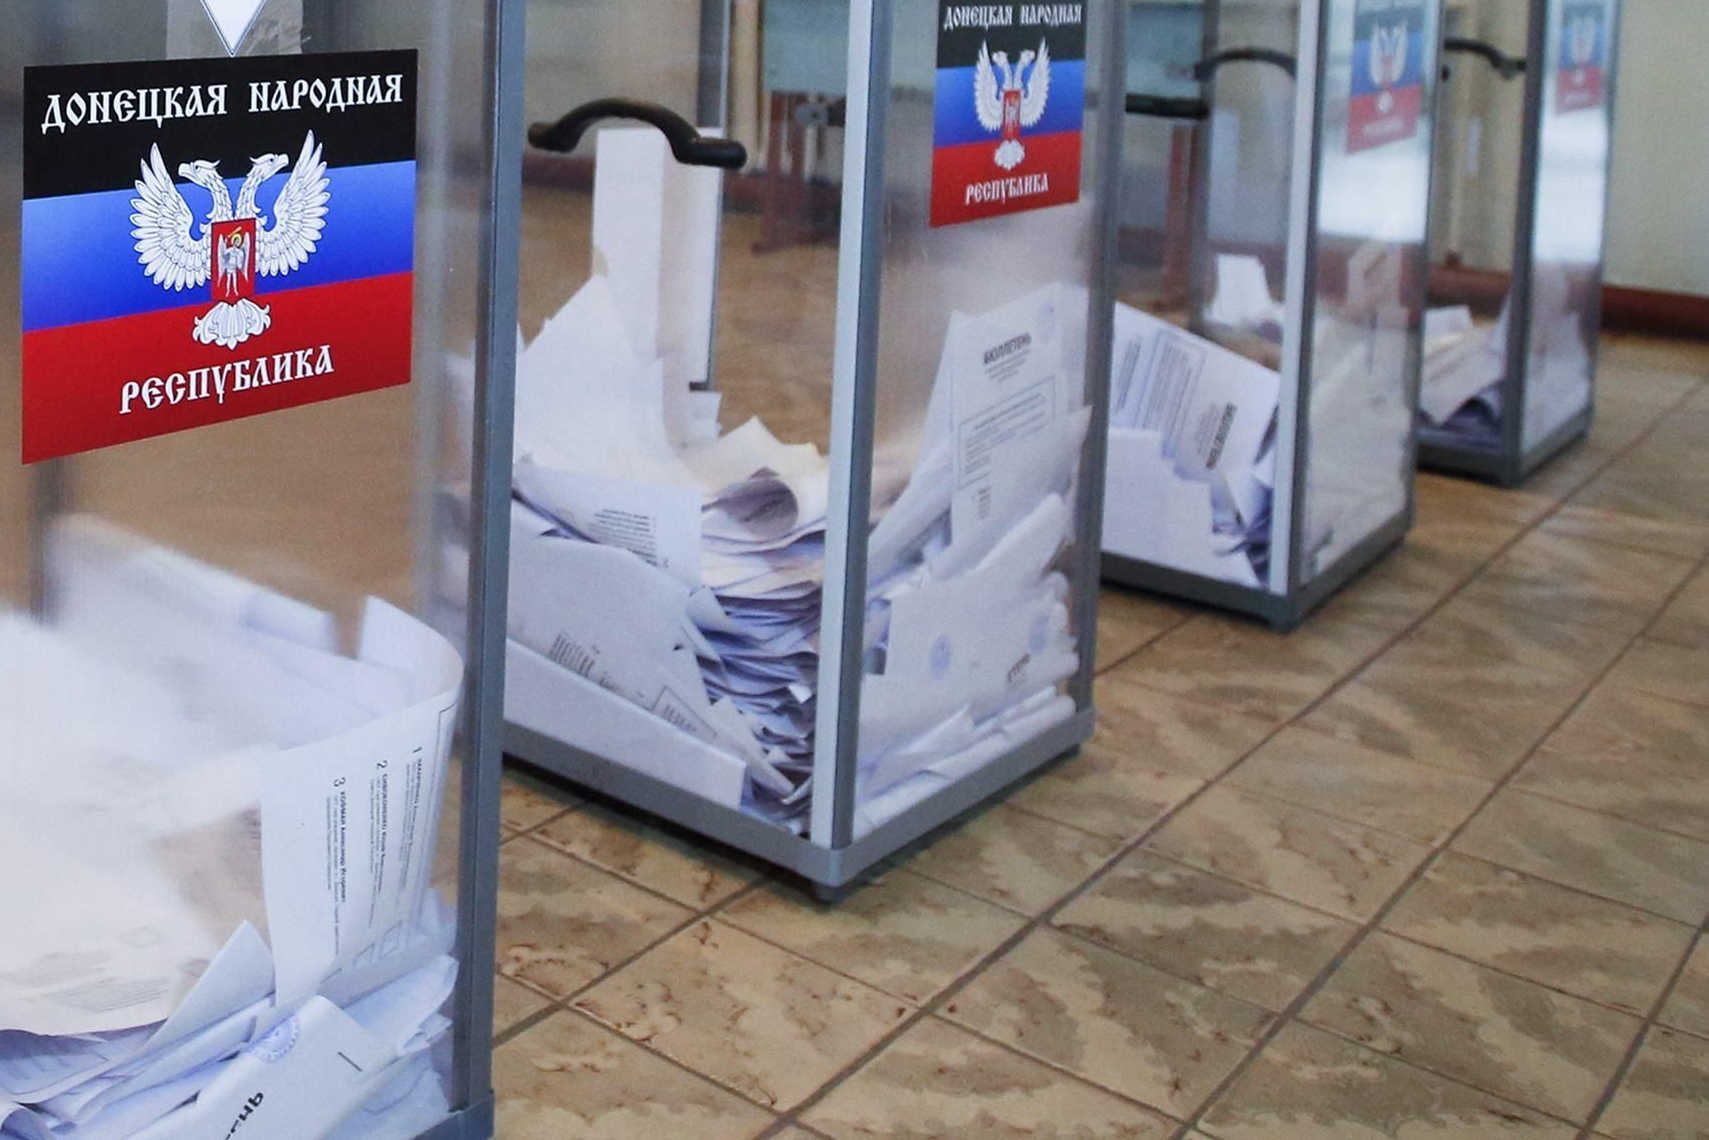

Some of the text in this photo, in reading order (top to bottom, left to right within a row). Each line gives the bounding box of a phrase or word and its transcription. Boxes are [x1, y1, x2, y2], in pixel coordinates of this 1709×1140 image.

[944, 3, 1082, 30] ДОНЕЦКАЯ НАРОДНАЯ
[41, 74, 403, 135] ДОНЕЦКАЯ НАРОДНАЯ
[965, 172, 1049, 205] РЕСПУБЛИКА
[119, 344, 335, 415] РЕСПУБЛИКА
